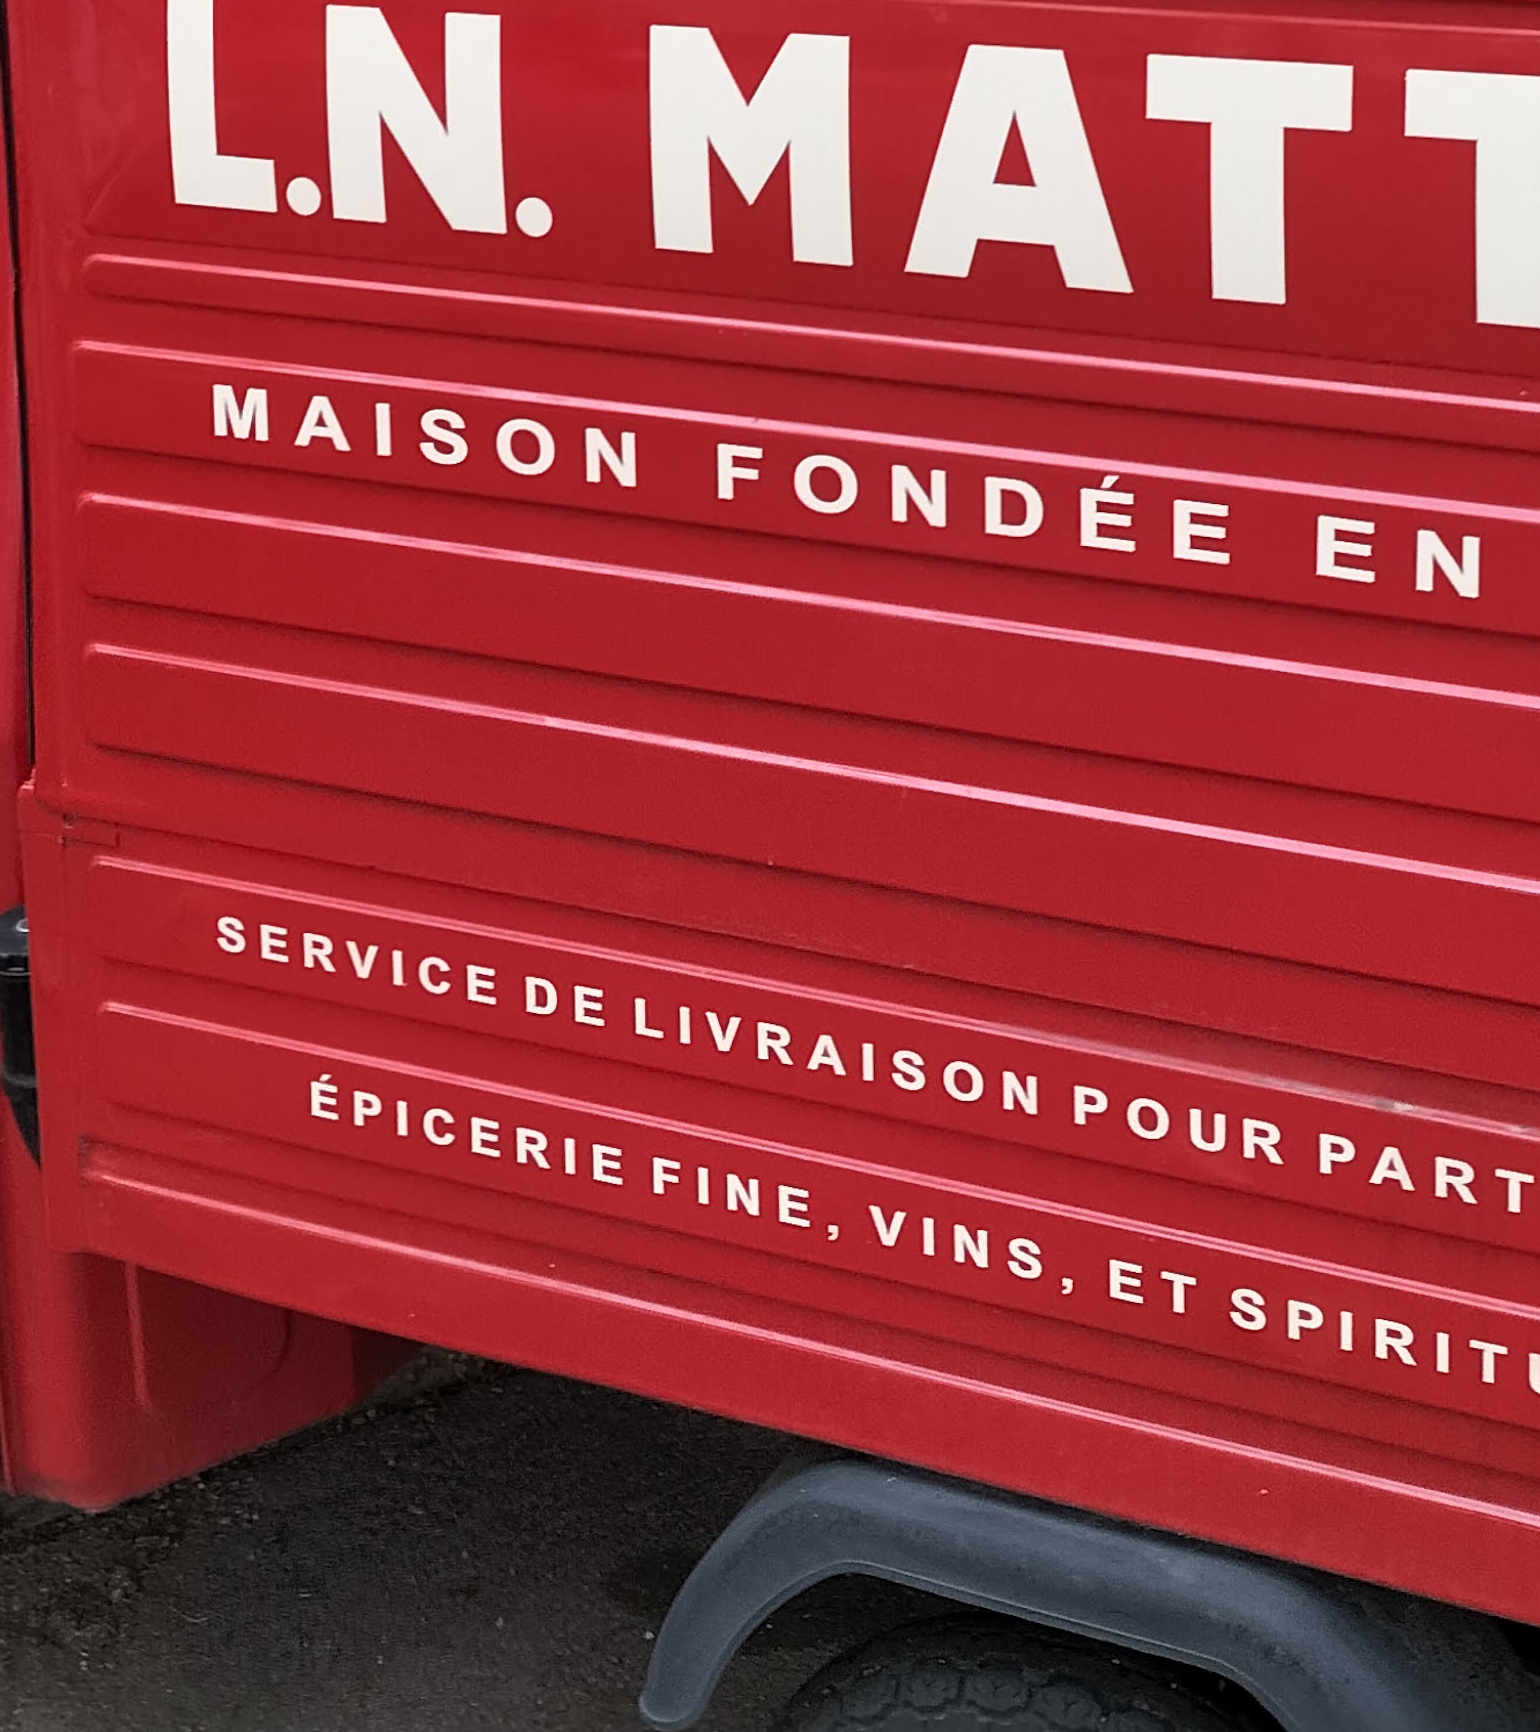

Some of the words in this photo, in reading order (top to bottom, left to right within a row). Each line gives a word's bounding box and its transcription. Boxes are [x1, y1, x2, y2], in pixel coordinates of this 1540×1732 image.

[212, 384, 638, 488] MAISON
[716, 443, 1231, 566] FONDÉE
[1315, 515, 1481, 600] EN
[216, 915, 498, 1006] SERVICE
[524, 976, 606, 1028] DE
[633, 997, 1039, 1116] LIVRAISON
[1073, 1084, 1285, 1166] POUR
[309, 1073, 624, 1186] ÉPICERIE
[651, 1155, 839, 1242] FINE,
[867, 1204, 1074, 1295] VINS,
[1108, 1258, 1198, 1315] ET
